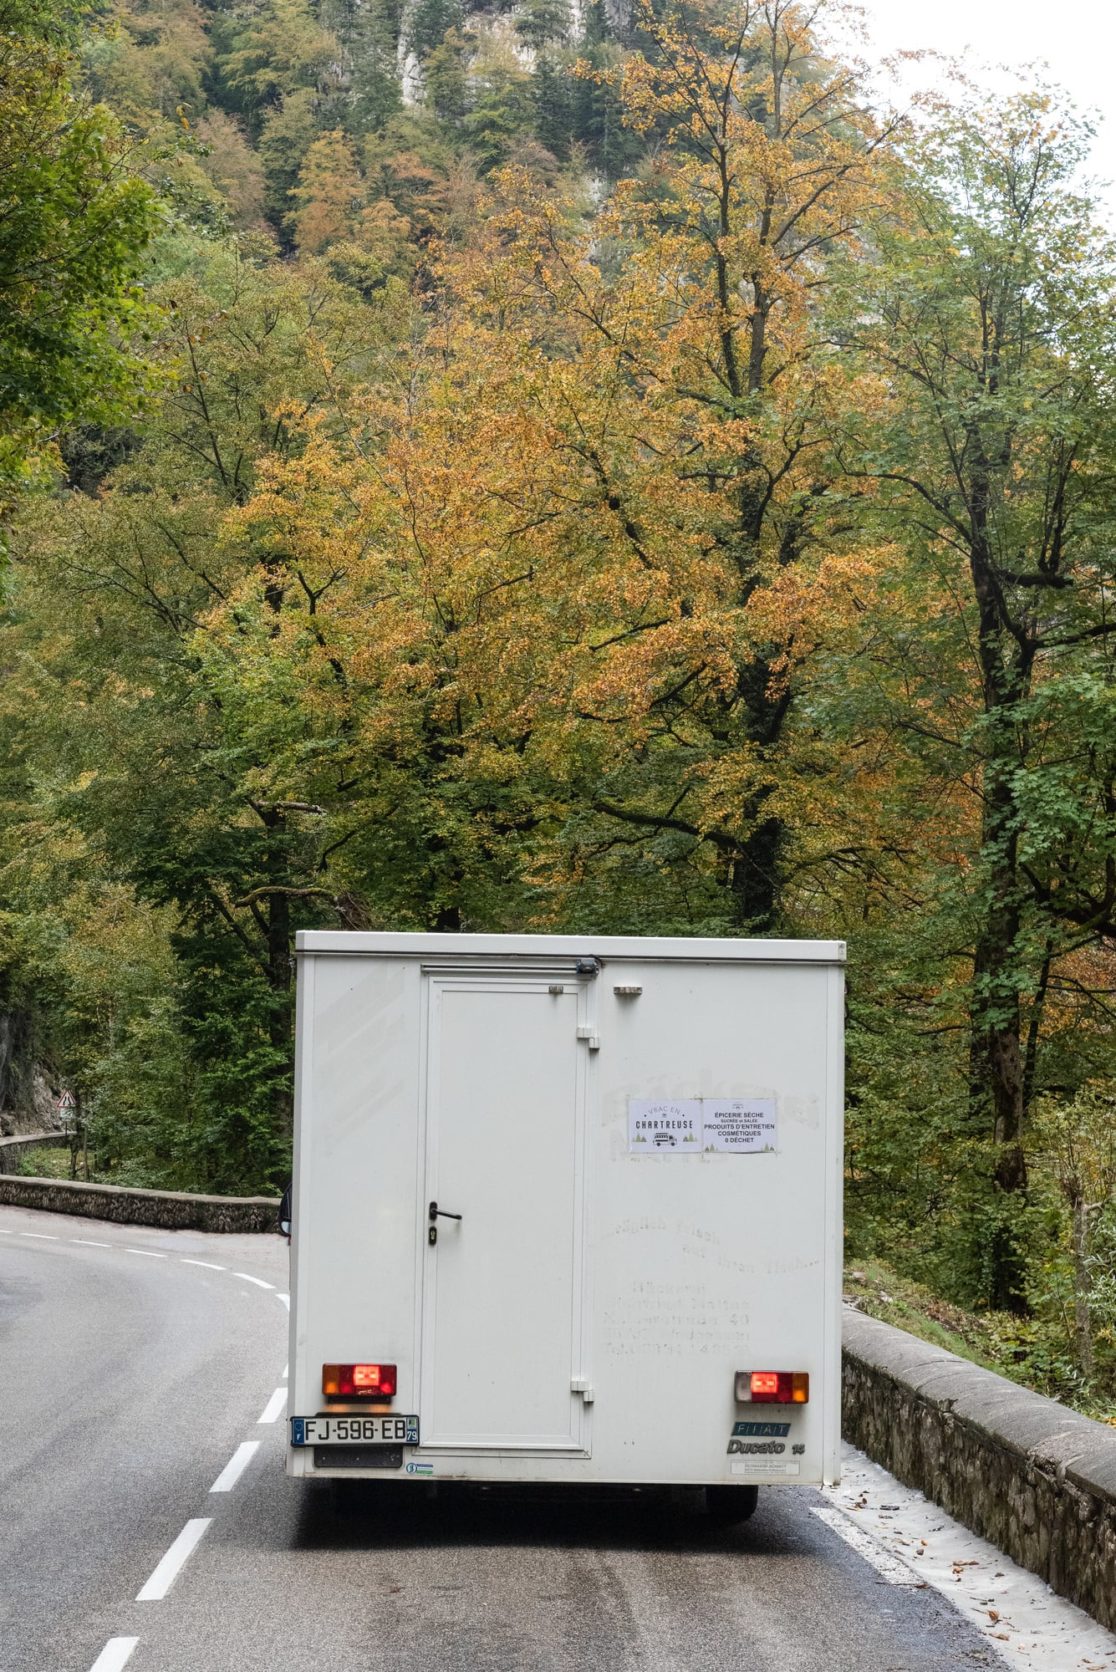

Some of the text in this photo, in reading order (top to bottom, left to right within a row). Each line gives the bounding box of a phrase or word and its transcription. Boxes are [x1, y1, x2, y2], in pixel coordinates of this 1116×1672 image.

[635, 1120, 693, 1130] CHARTREUSE
[305, 1420, 406, 1440] FJ-596-EB
[737, 1424, 787, 1434] FIAT
[407, 1431, 417, 1441] 79
[727, 1439, 785, 1455] Ducato
